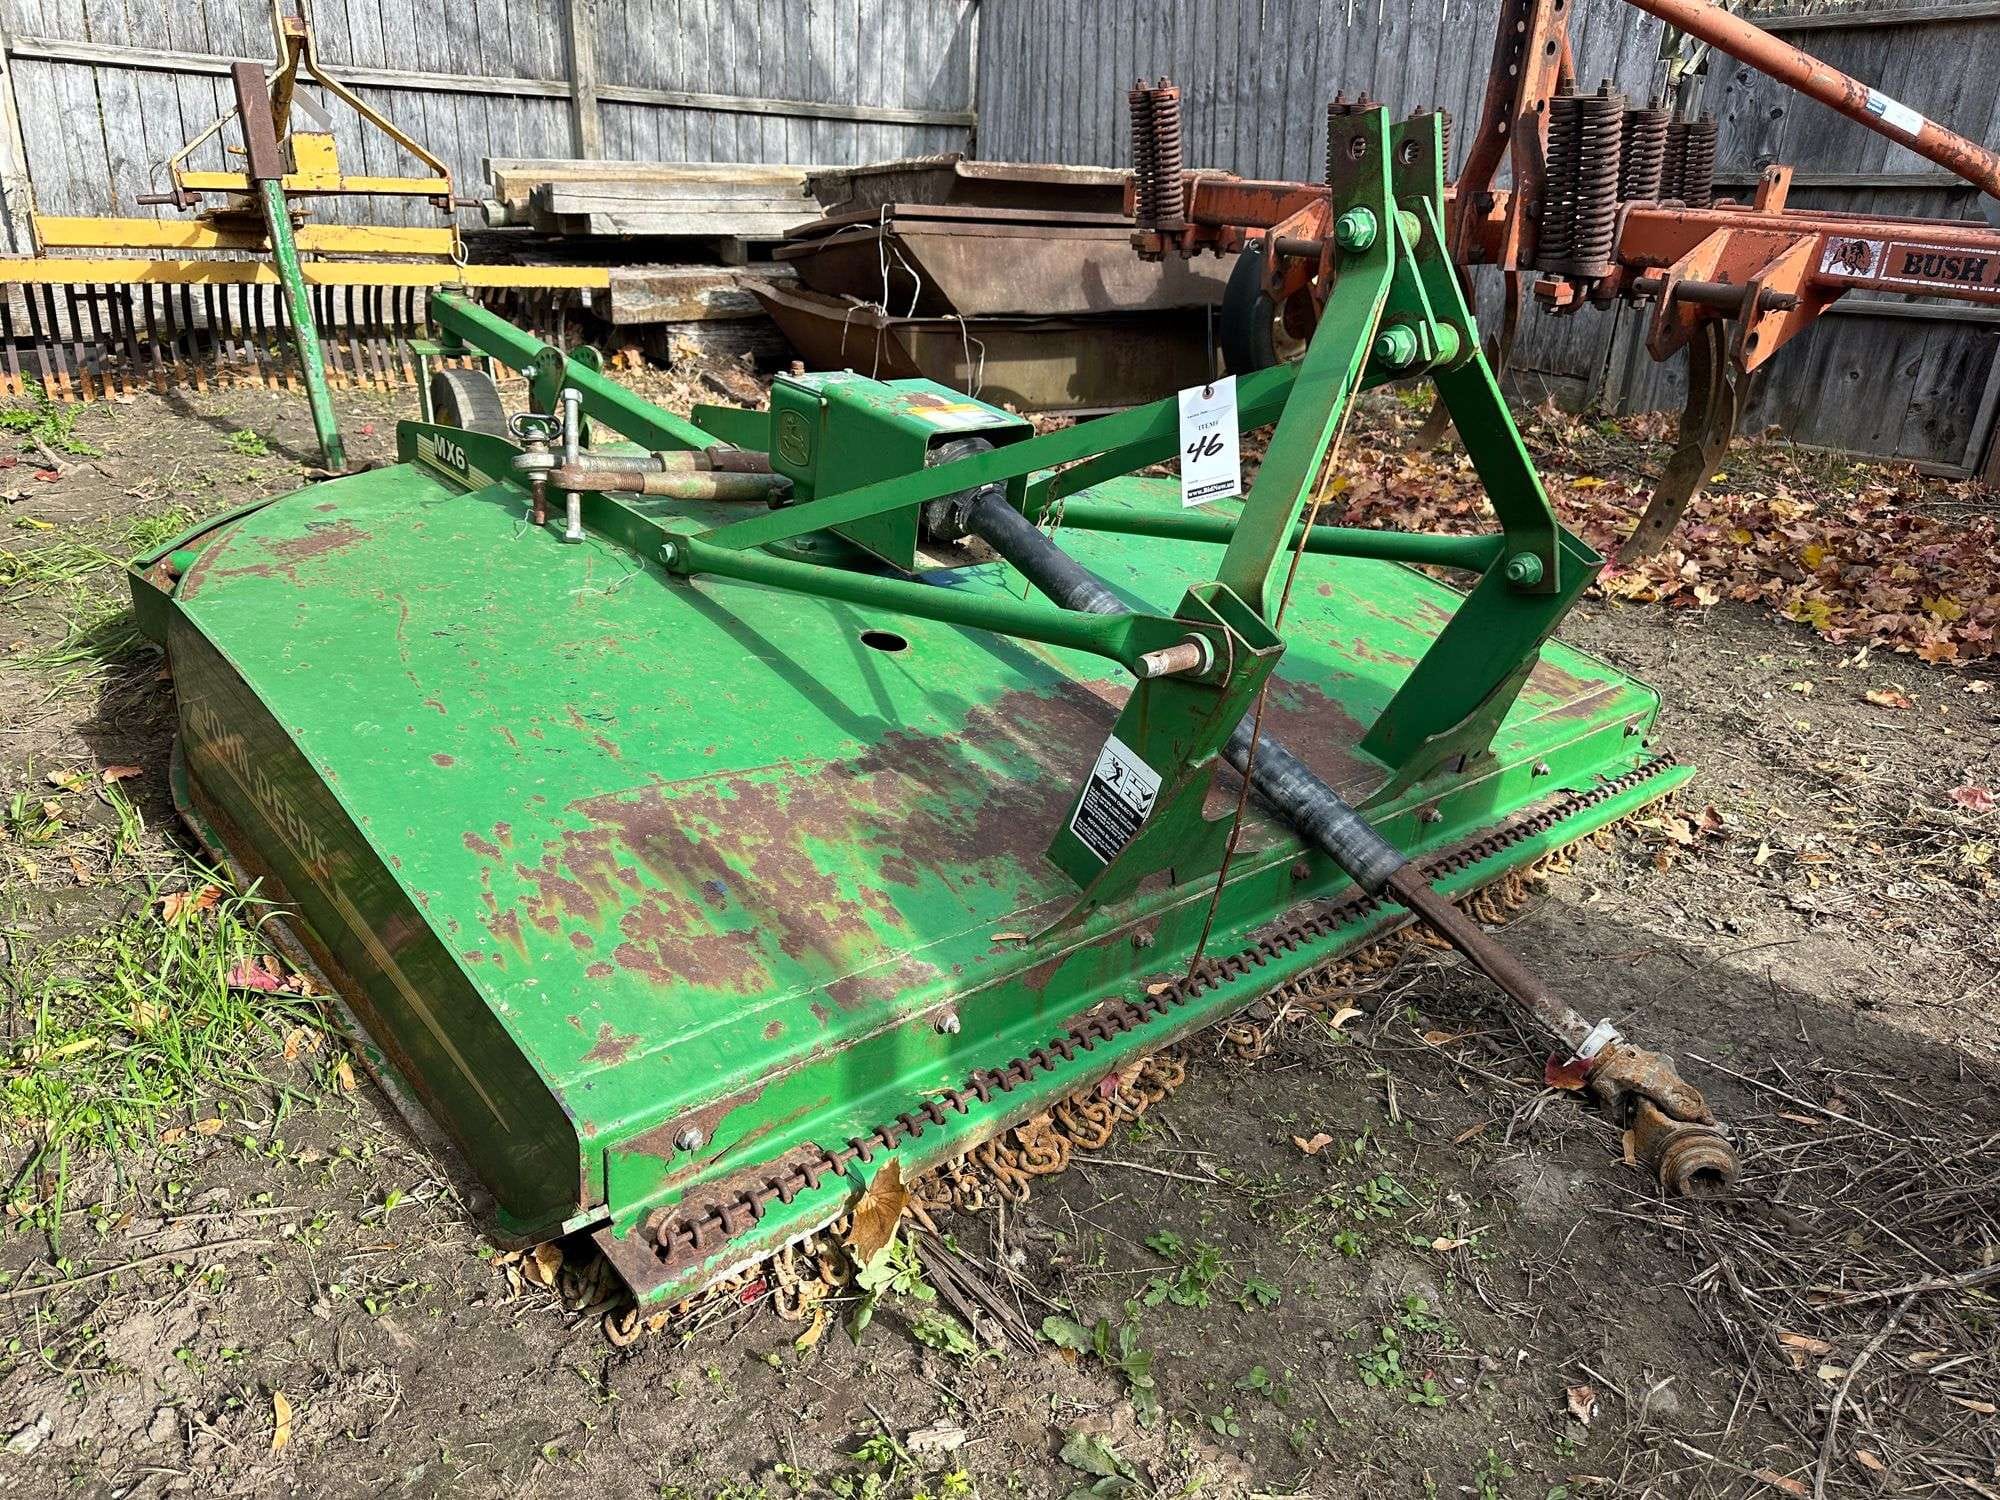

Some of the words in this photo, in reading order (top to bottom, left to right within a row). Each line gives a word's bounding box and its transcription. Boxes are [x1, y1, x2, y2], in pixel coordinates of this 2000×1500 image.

[1902, 251, 1988, 283] BUSH
[433, 432, 467, 470] MX6
[1187, 433, 1224, 462] 46
[255, 764, 329, 880] DEERE
